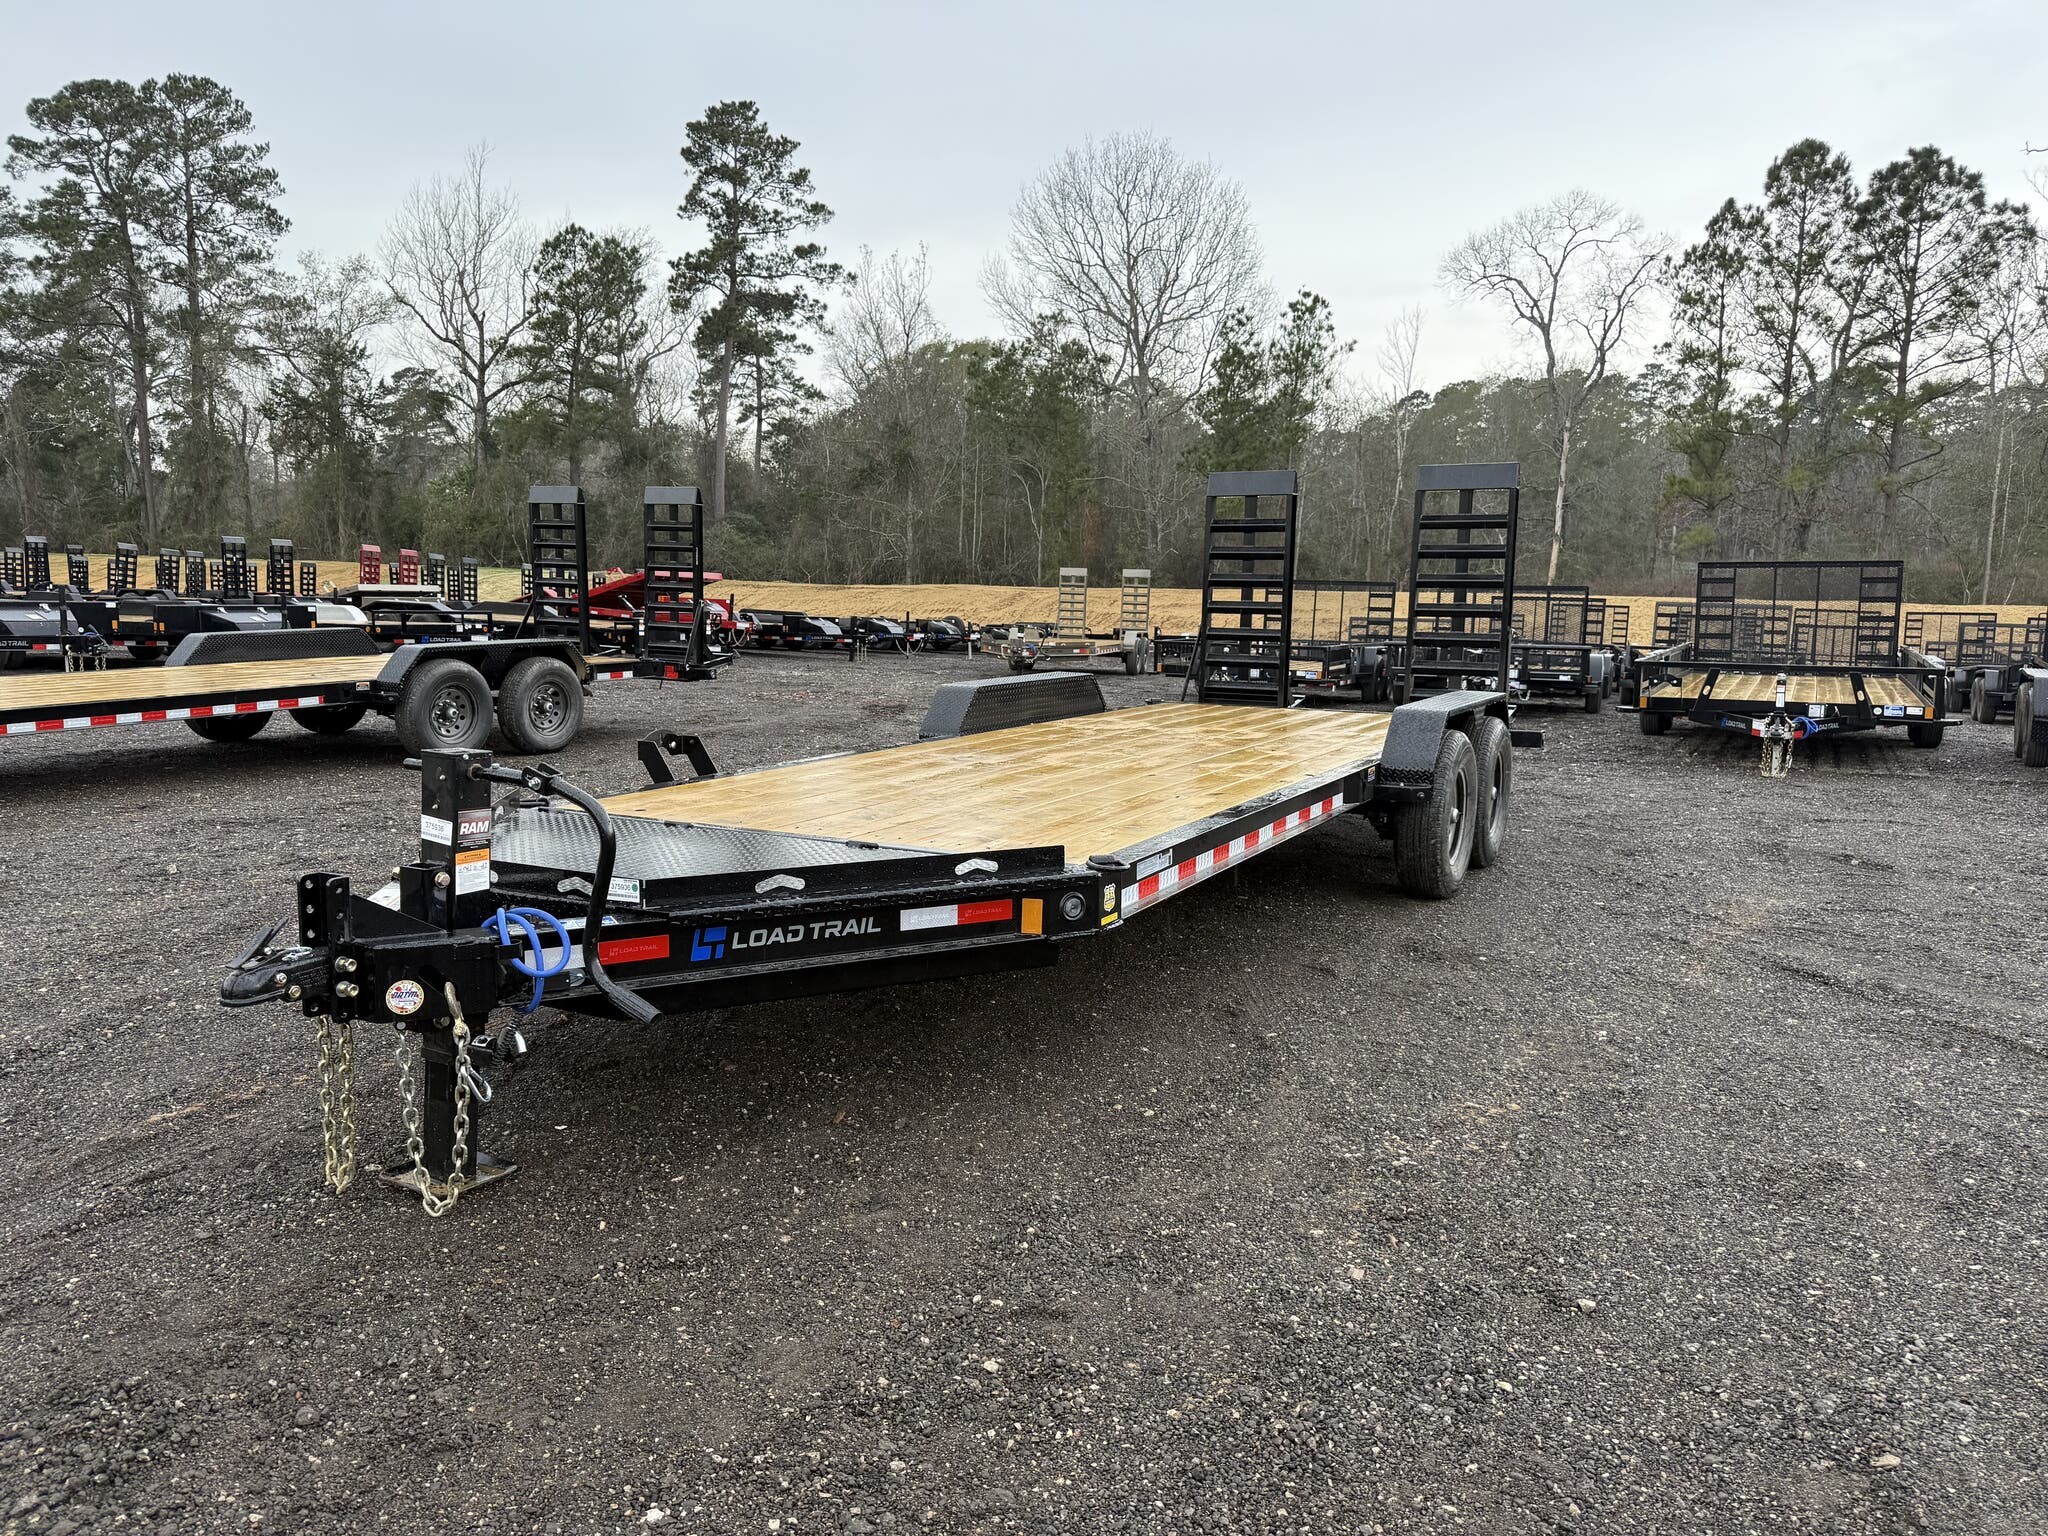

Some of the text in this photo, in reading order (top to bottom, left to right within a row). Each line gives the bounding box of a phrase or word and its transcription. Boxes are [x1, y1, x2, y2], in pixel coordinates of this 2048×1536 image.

[460, 820, 490, 835] RAM
[731, 925, 805, 950] LOAD
[809, 916, 882, 940] TRAIL
